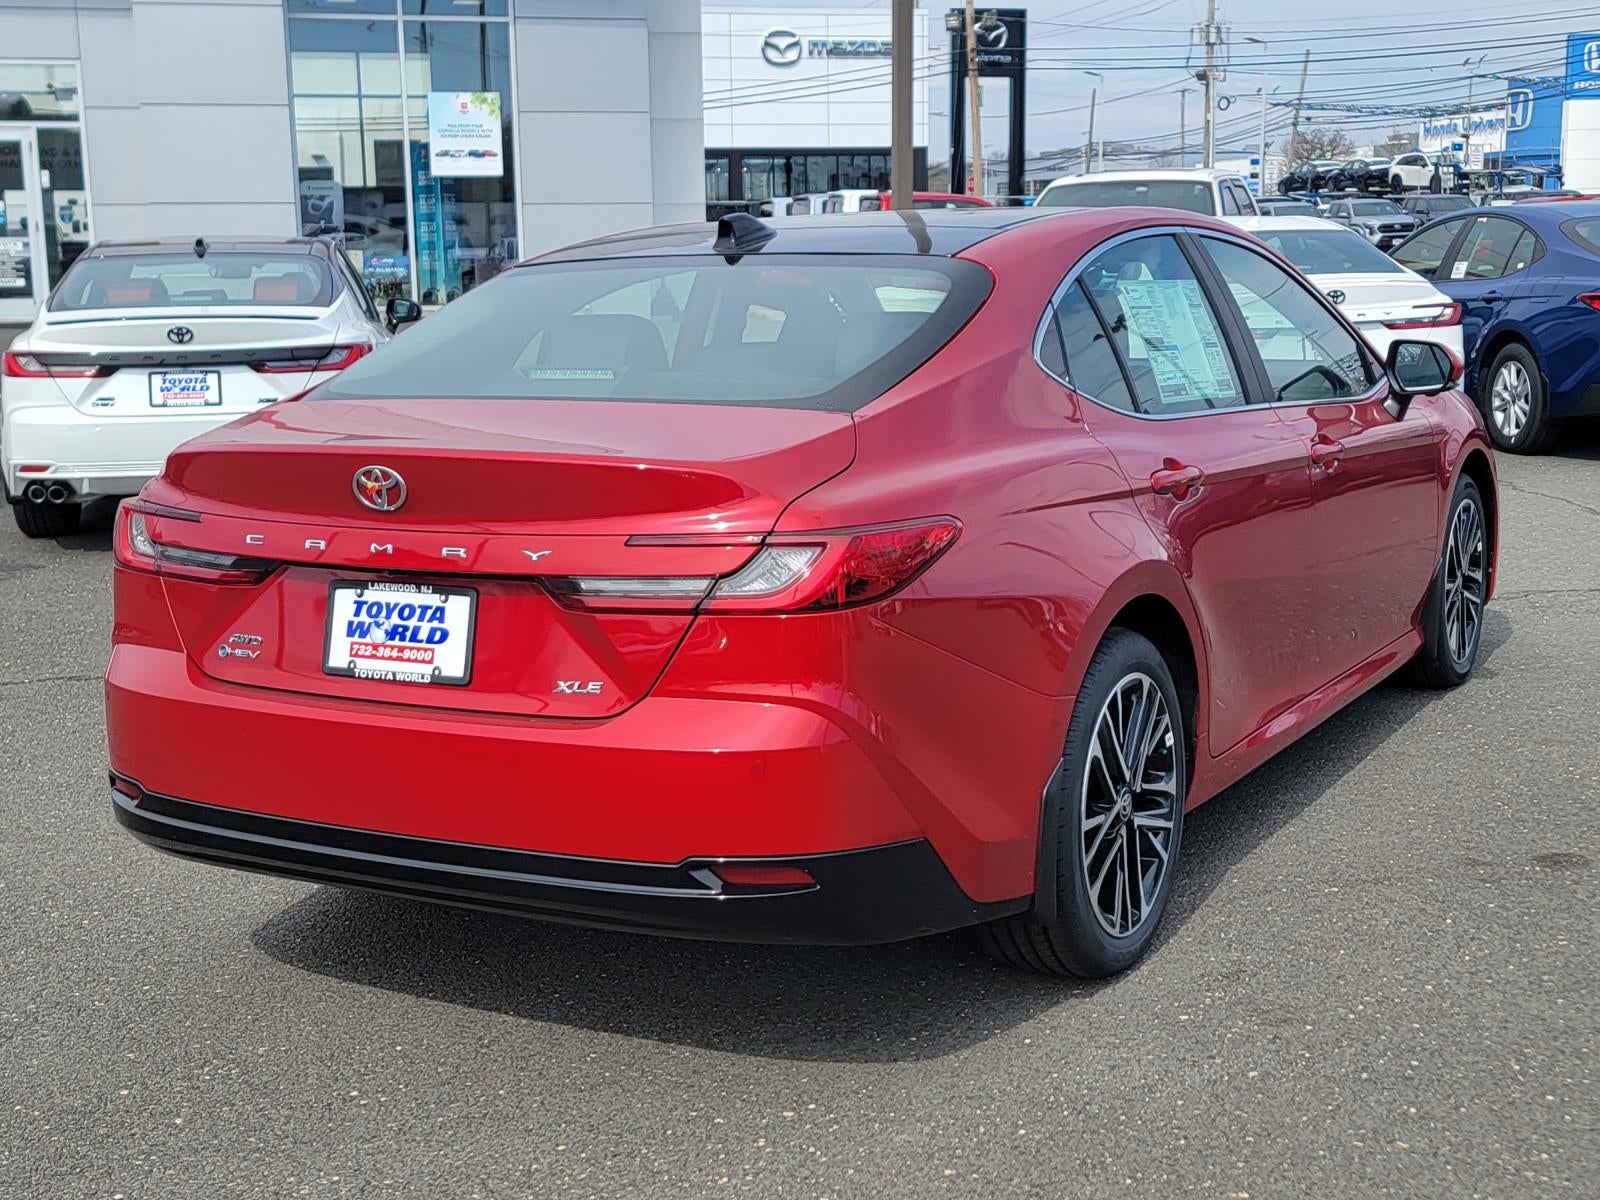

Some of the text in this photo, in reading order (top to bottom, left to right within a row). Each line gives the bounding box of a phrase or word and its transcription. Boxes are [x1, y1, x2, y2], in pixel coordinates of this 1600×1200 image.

[1423, 120, 1458, 137] Honda
[161, 376, 207, 385] TOYOTA
[245, 533, 553, 562] CAMRY
[420, 585, 433, 594] NJ
[353, 600, 446, 624] TOYOTA
[351, 644, 433, 661] 732-364-9000
[354, 668, 432, 684] TOYOTA WORLD
[551, 680, 605, 696] XLE
